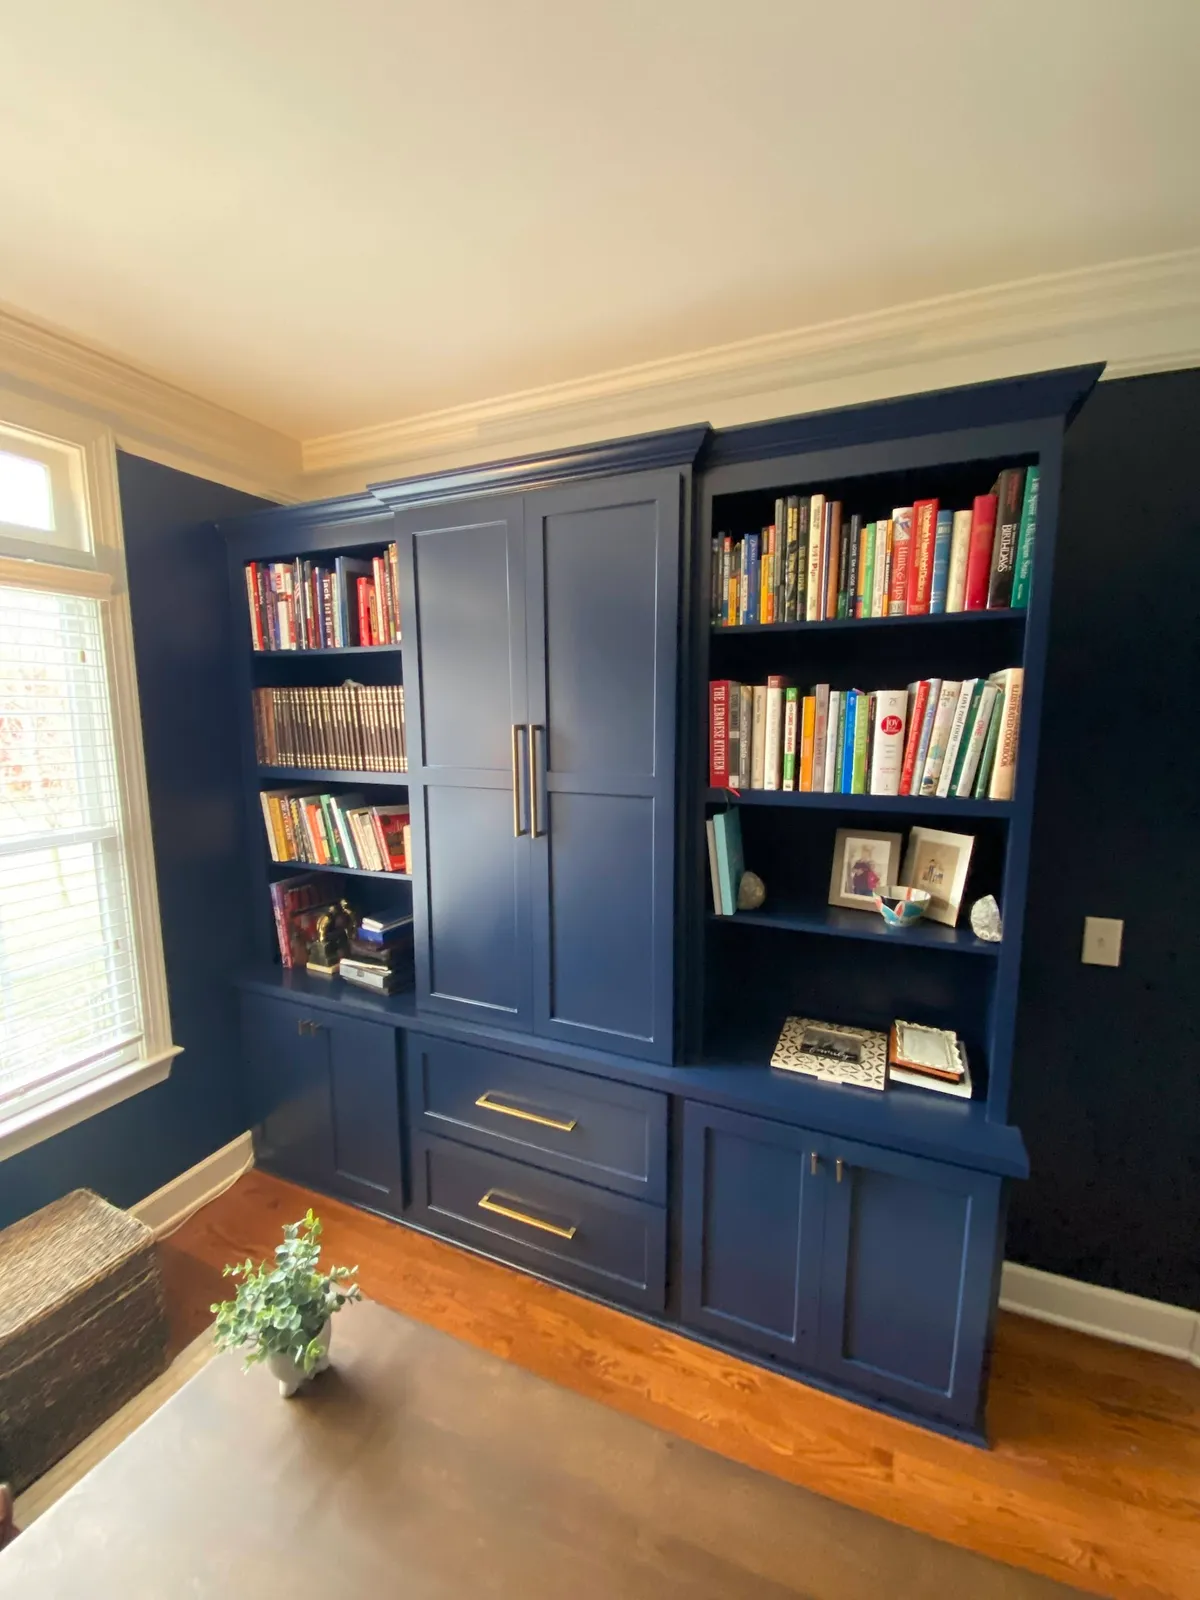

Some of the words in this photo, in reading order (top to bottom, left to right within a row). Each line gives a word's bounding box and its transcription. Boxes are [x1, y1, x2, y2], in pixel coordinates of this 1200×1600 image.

[997, 524, 1012, 572] BIRTHDAYS
[1022, 523, 1036, 558] Michigan
[898, 547, 908, 570] Hints
[714, 687, 725, 701] THE
[1006, 684, 1019, 728] ILLUSTRATED
[714, 704, 725, 738] LEBANESE
[714, 740, 725, 770] KITCHEN
[1000, 729, 1013, 767] COOKBOOK
